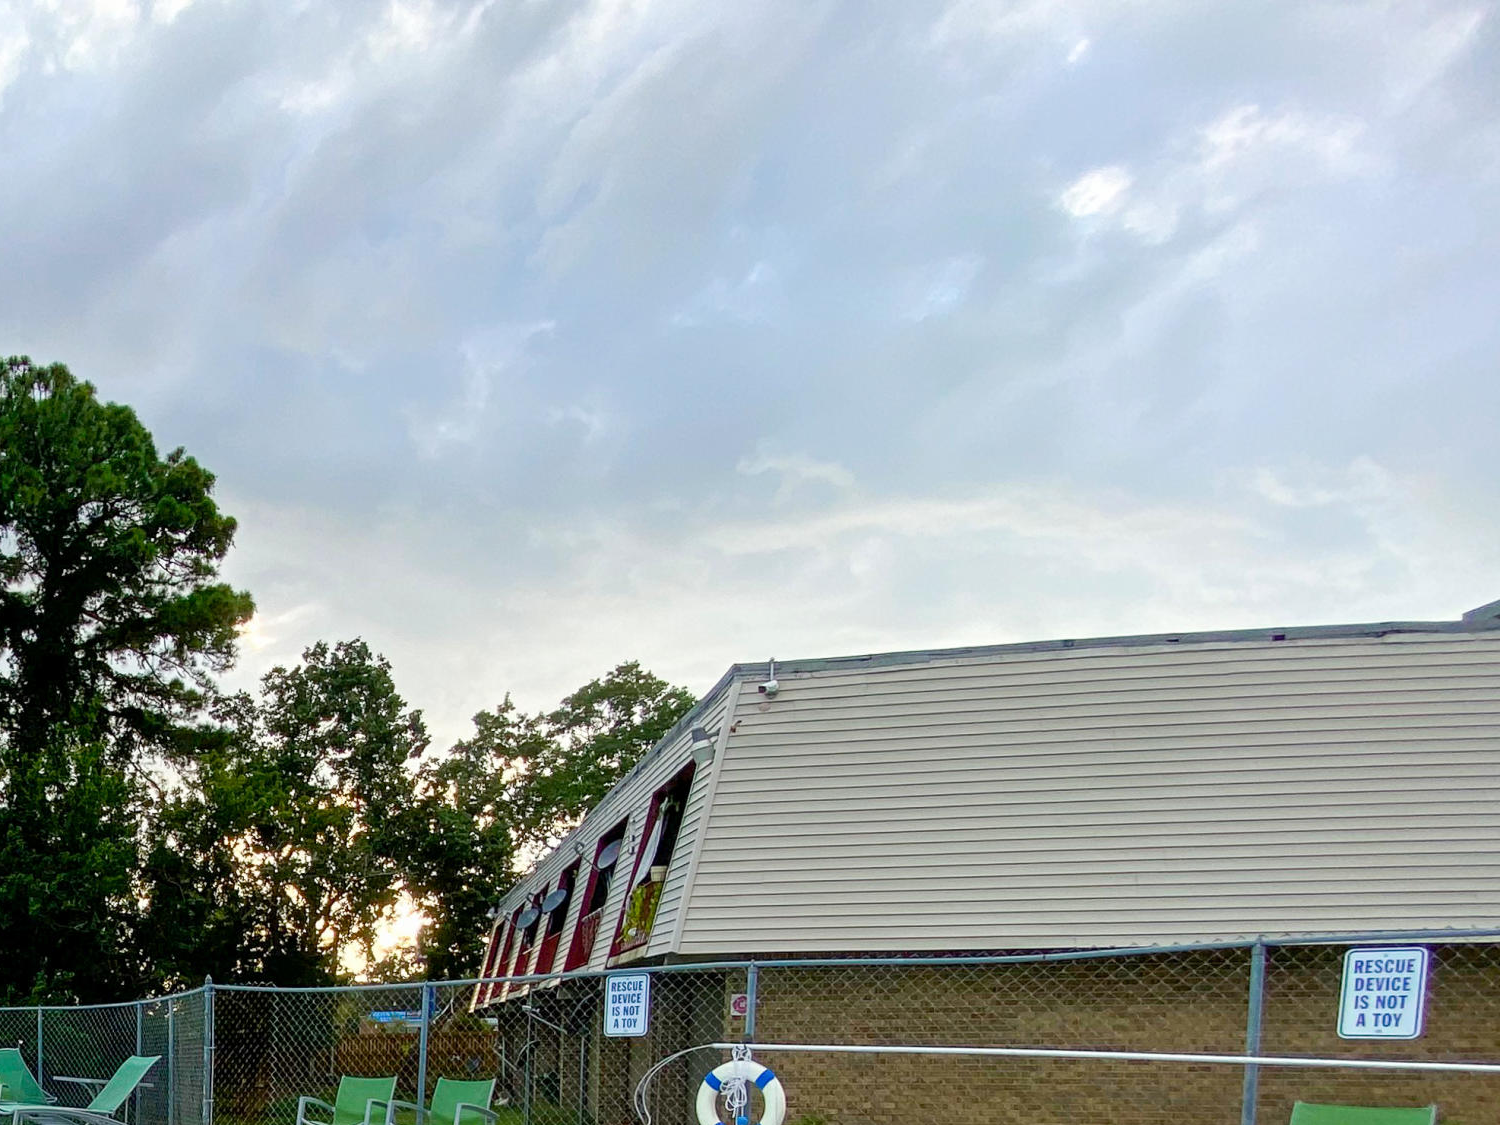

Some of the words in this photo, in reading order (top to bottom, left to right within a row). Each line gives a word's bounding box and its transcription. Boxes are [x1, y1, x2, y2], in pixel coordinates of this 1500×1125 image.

[1354, 959, 1416, 973] RESCUE
[611, 981, 643, 992] RESCUE
[1355, 976, 1412, 991] DEVICE
[611, 993, 642, 1004] DEVICE
[1354, 995, 1369, 1009] IS
[1375, 994, 1408, 1009] NOT
[612, 1006, 620, 1016] IS
[623, 1005, 640, 1016] NOT
[613, 1018, 619, 1028] A
[621, 1018, 637, 1028] TOY
[1355, 1013, 1366, 1027] A
[1372, 1012, 1402, 1027] TOY
